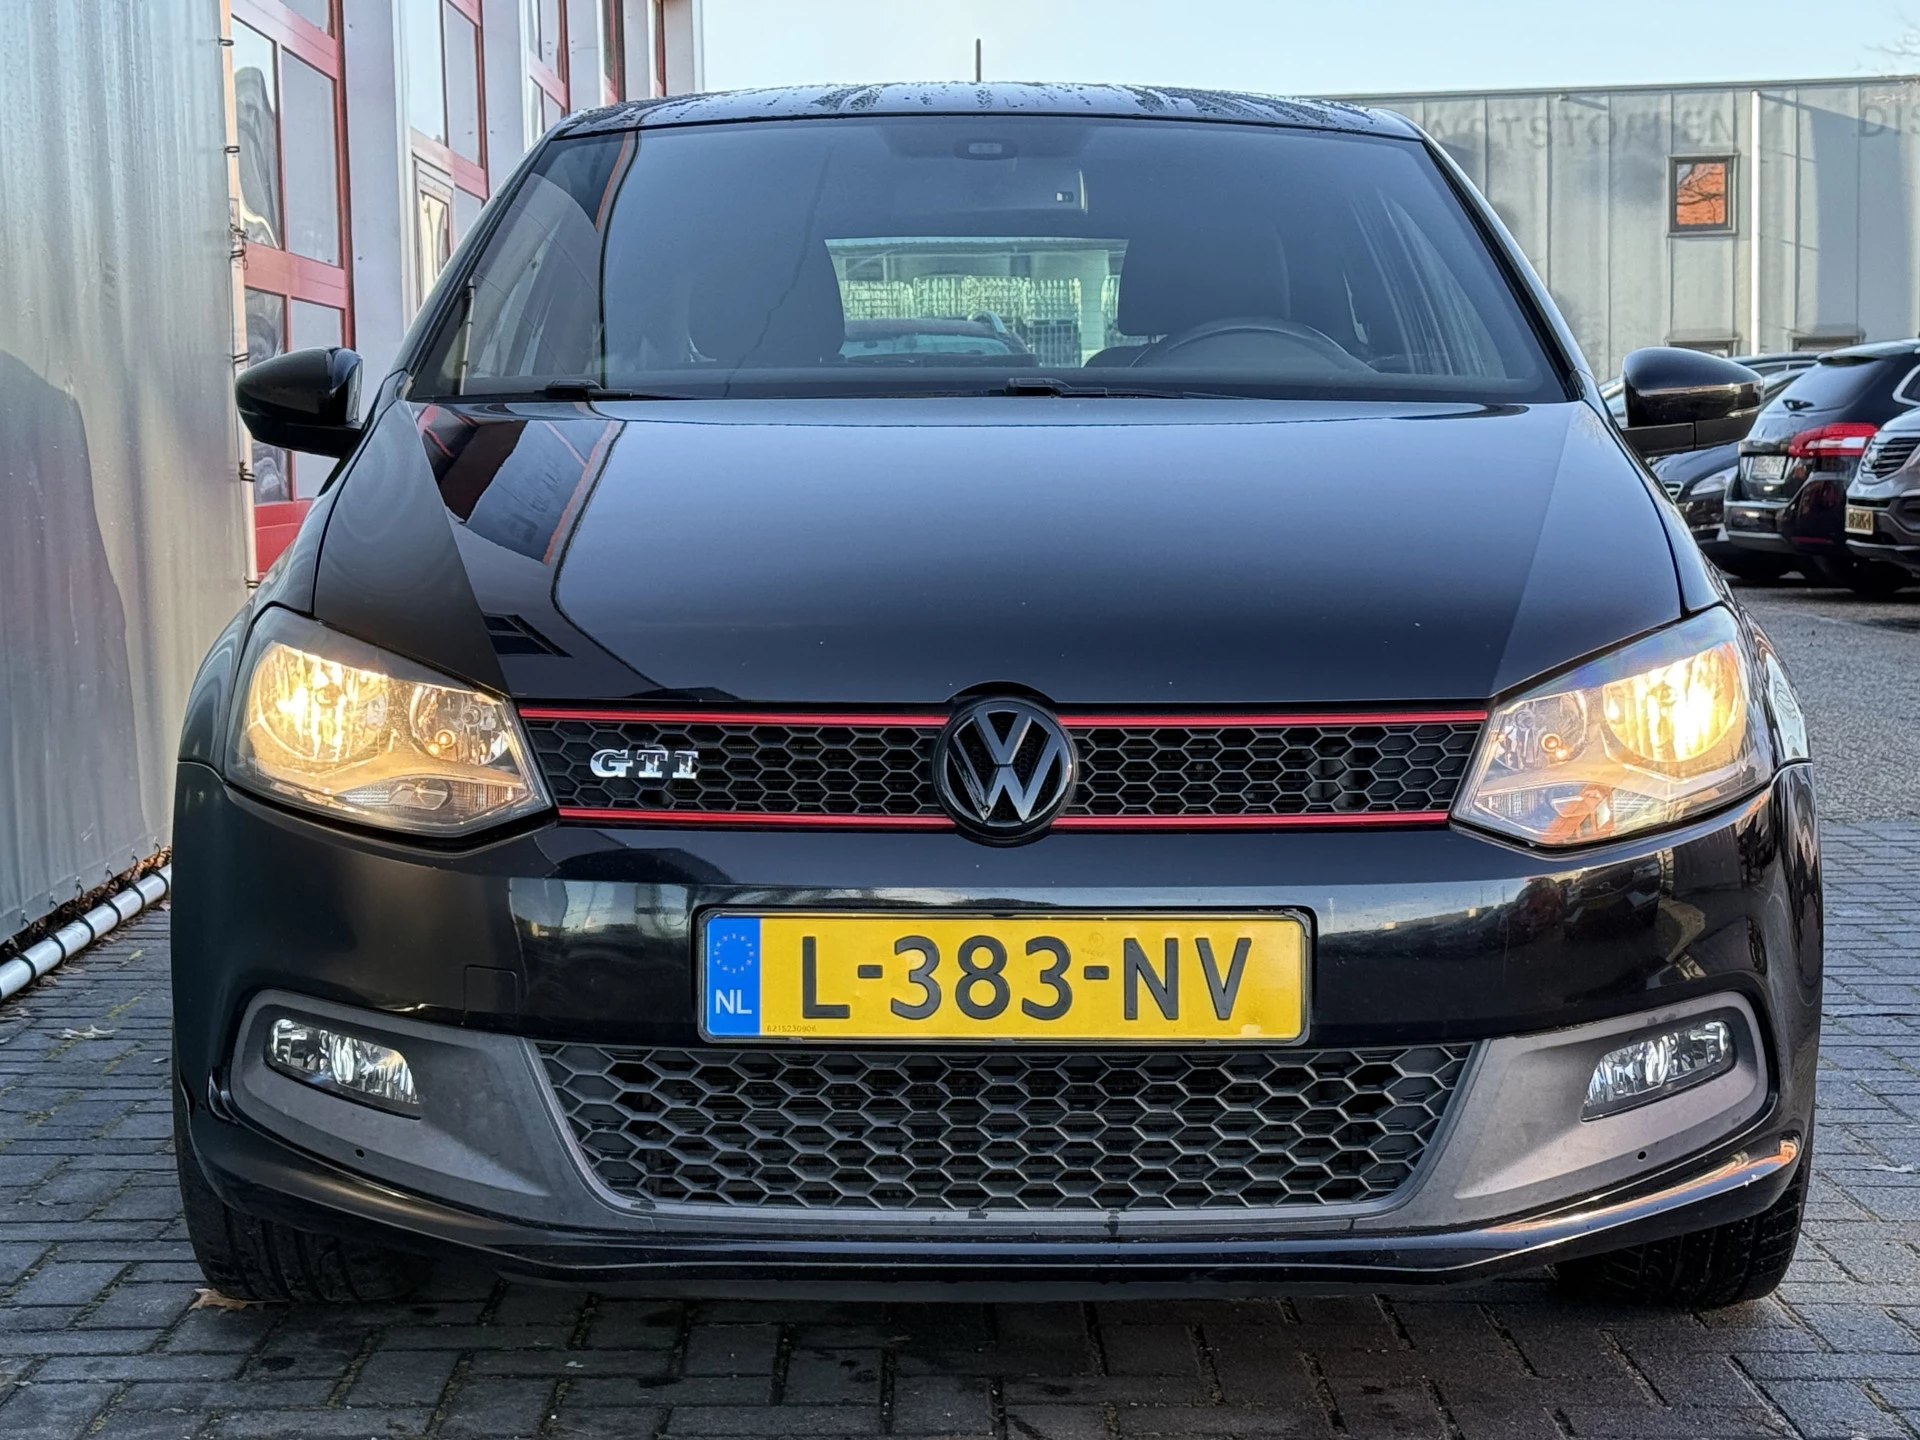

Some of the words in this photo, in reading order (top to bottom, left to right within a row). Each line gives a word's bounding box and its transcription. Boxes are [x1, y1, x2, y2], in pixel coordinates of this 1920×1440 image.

[590, 748, 699, 779] GTI
[942, 702, 1070, 828] VW
[715, 989, 753, 1015] NL
[801, 935, 1252, 1020] L-383-NV
